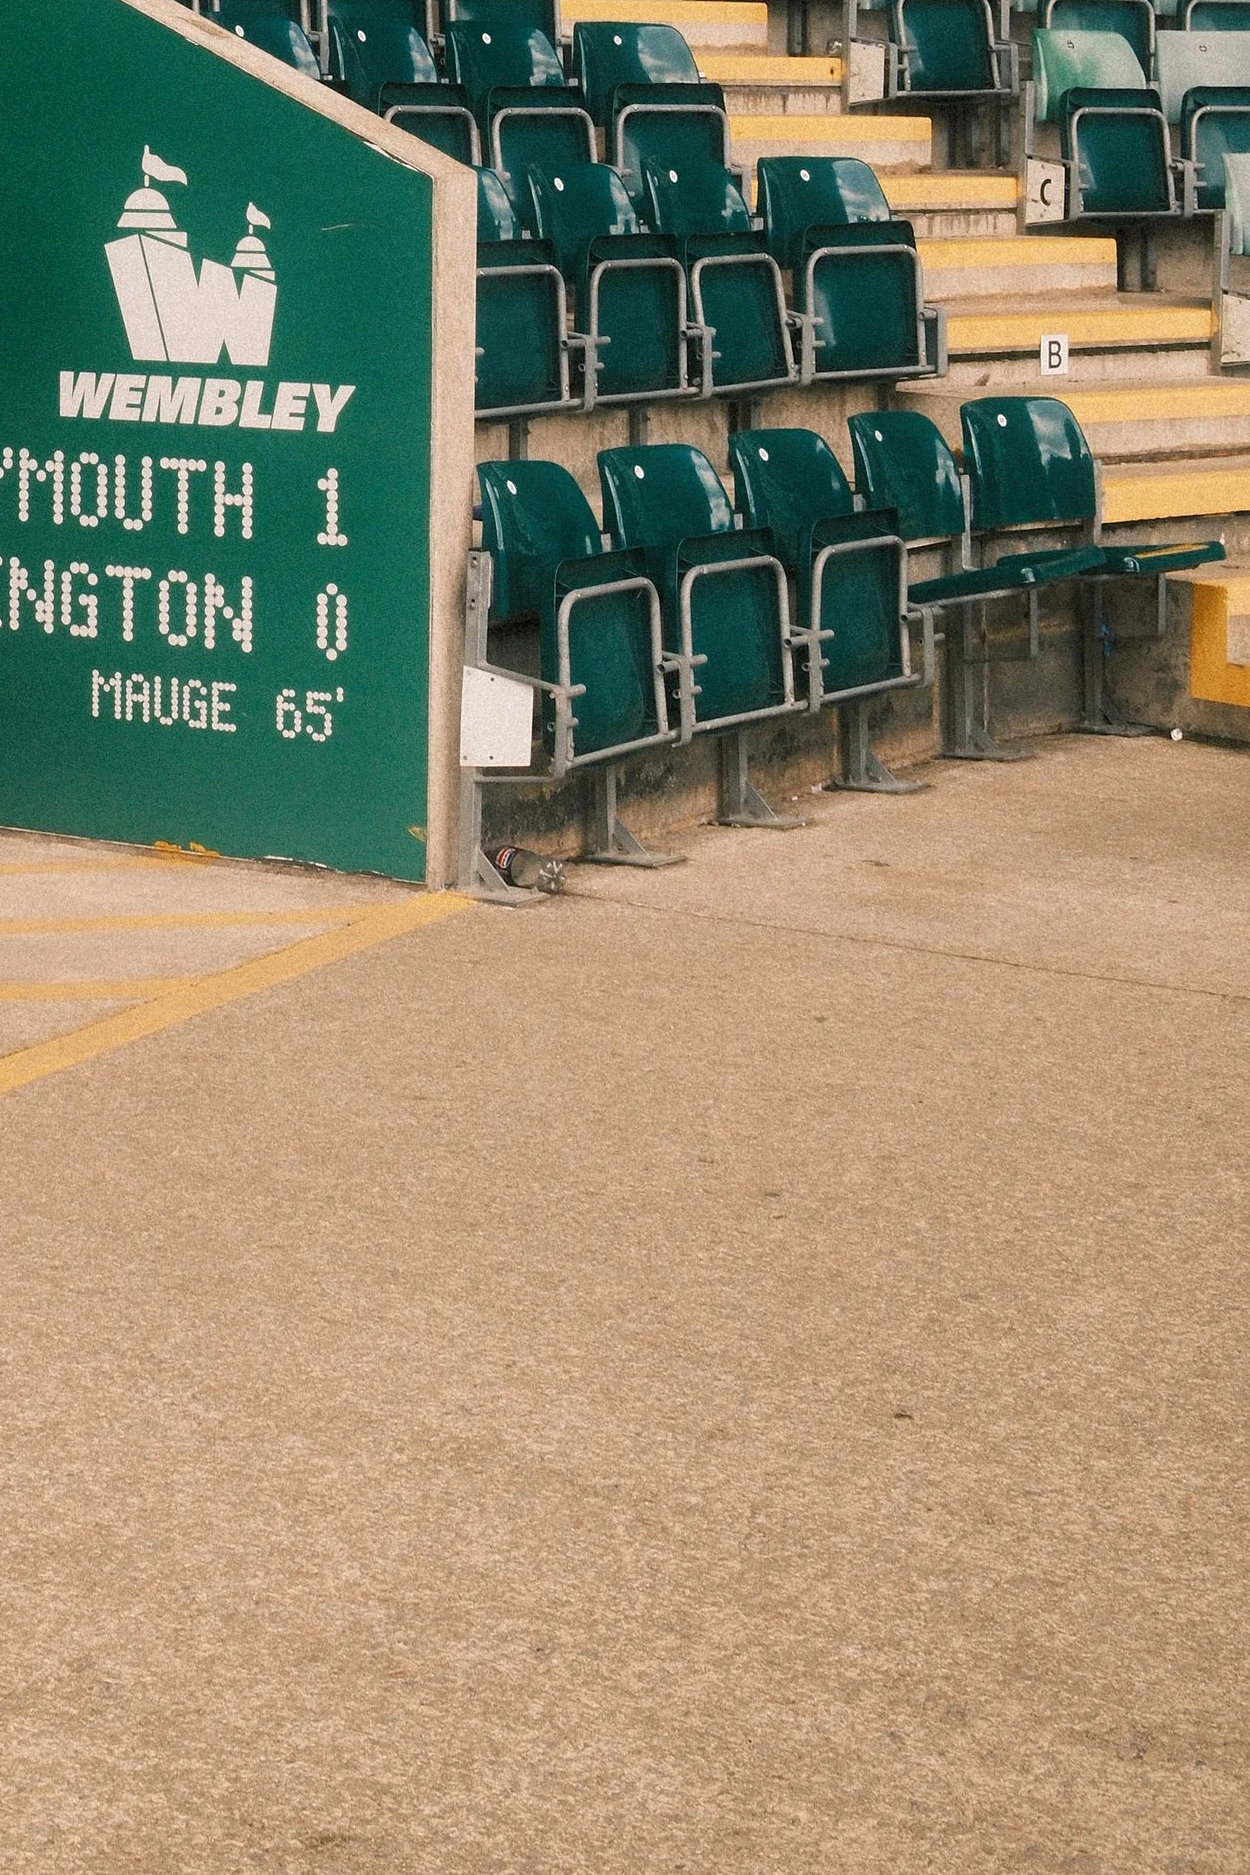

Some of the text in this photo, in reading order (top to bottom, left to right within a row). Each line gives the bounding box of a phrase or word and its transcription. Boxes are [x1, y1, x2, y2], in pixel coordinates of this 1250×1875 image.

[1040, 178, 1051, 206] C
[1048, 340, 1062, 369] B
[59, 371, 356, 433] WEMBLEY
[317, 468, 348, 546] 1
[316, 583, 348, 661] 0
[91, 670, 237, 732] MAUGE
